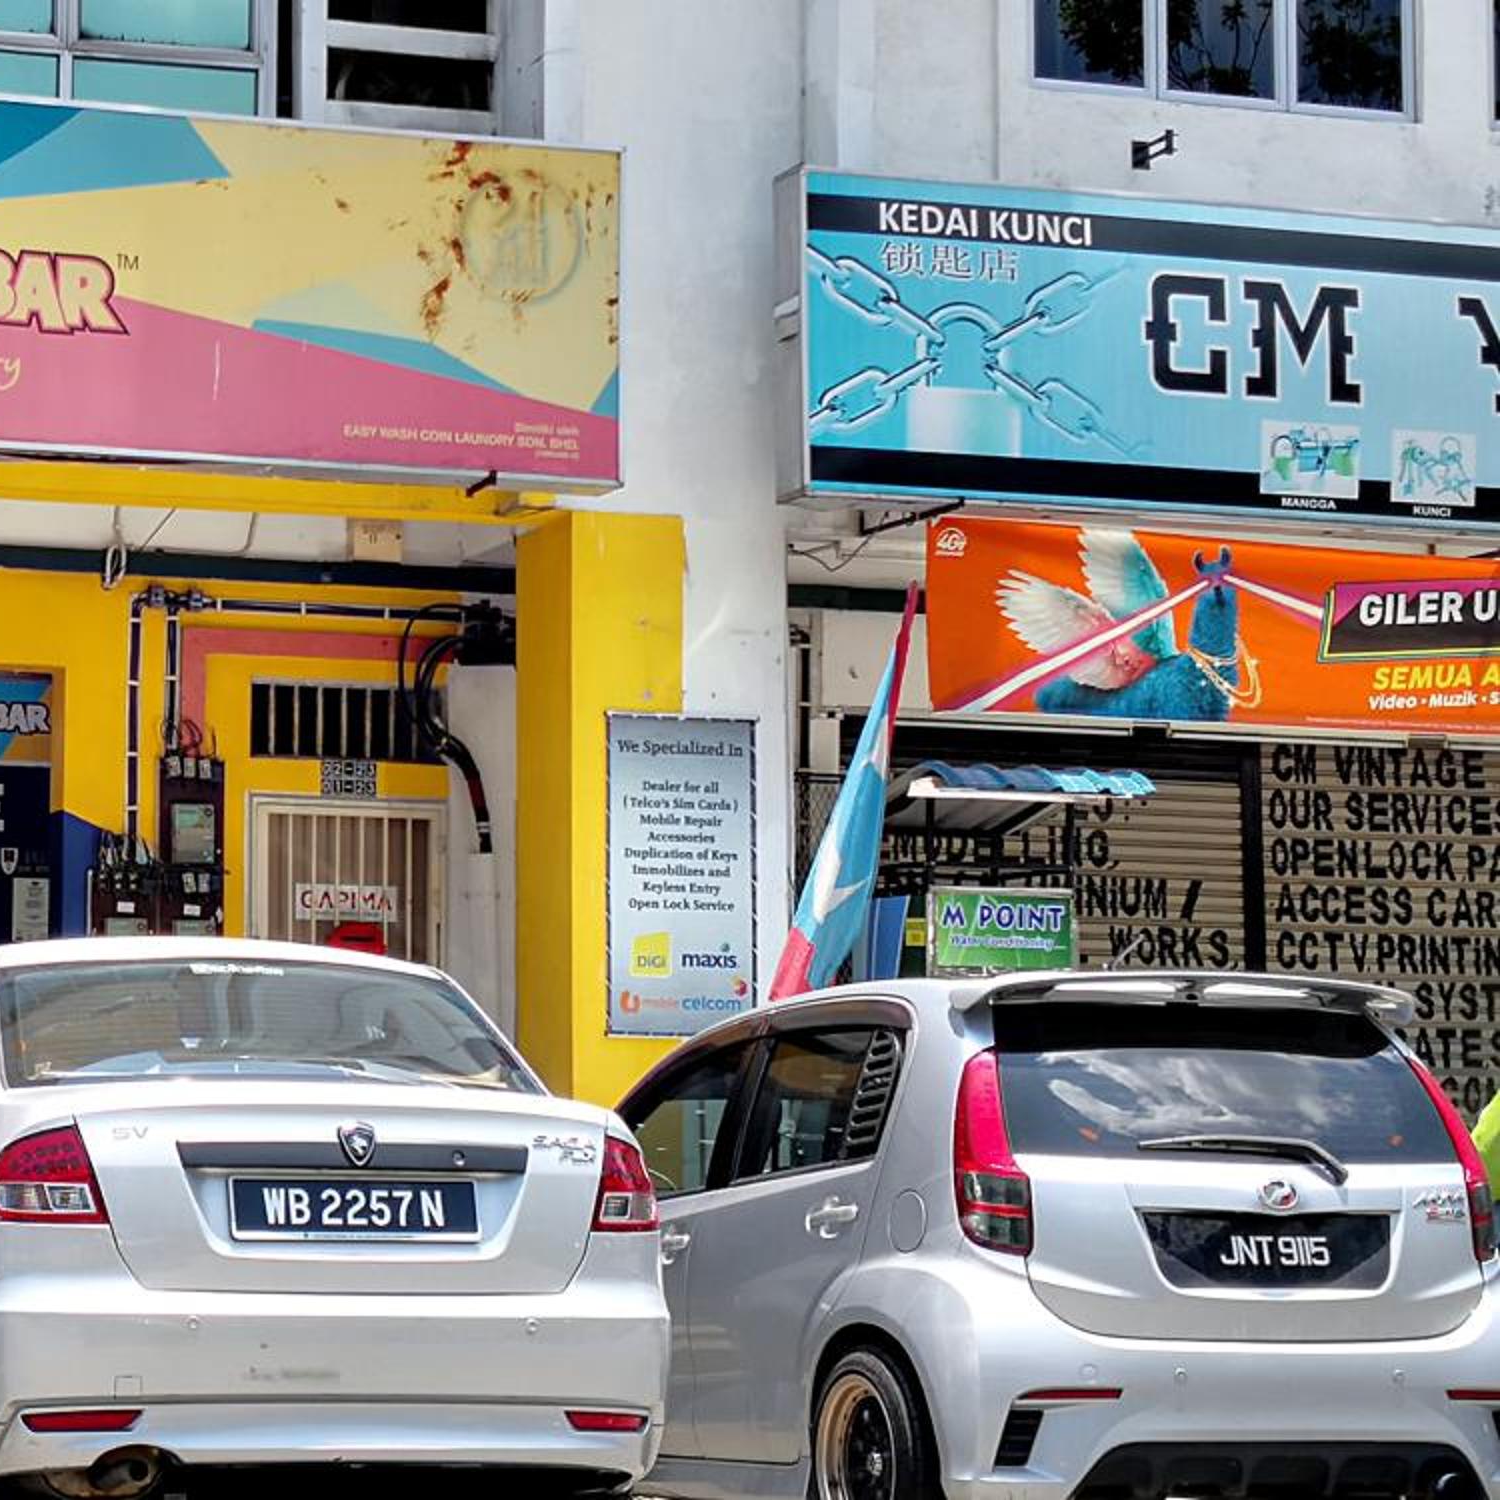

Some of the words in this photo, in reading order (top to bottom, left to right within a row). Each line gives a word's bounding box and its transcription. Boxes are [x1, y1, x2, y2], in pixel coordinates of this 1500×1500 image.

[879, 202, 978, 237] KEDAI
[989, 210, 1092, 246] KUNCI
[879, 241, 1020, 283] 锁匙店
[1144, 271, 1362, 404] CM
[343, 424, 376, 438] EASY
[379, 426, 417, 441] WASH
[420, 429, 452, 443] COIN
[455, 432, 514, 447] LAUNDRY
[1281, 497, 1337, 510] MANGGA
[1413, 505, 1451, 517] KUNCI
[1359, 591, 1463, 626] GILER
[1473, 589, 1500, 622] U
[1373, 664, 1472, 690] SEMUA
[1369, 694, 1417, 711] Video
[1429, 691, 1477, 708] Muzik
[617, 739, 640, 753] We
[642, 740, 724, 757] Specialized
[728, 743, 743, 757] In
[1272, 745, 1317, 784] CM
[1334, 746, 1485, 788] VINTAGE
[643, 780, 681, 792] Dealer
[684, 780, 702, 793] for
[704, 781, 719, 793] all
[672, 799, 695, 809] Sim
[698, 799, 732, 811] Cards
[1269, 788, 1333, 832] OUR
[640, 814, 681, 825] Mobile
[684, 815, 722, 828] Repair
[647, 832, 715, 843] Accessories
[624, 847, 693, 860] Duplication
[696, 848, 709, 860] of
[712, 850, 738, 862] Keys
[708, 866, 731, 877] and
[643, 882, 686, 894] Keyless
[689, 883, 721, 896] Entry
[629, 898, 659, 911] Open
[663, 898, 691, 910] Lock
[693, 899, 735, 911] Service
[1276, 883, 1413, 926] ACCESS
[941, 903, 966, 929] M
[978, 903, 1065, 932] POINT
[681, 947, 738, 968] maxis
[681, 996, 740, 1011] celcom
[111, 1126, 149, 1140] SV
[262, 1187, 311, 1226] WB
[1219, 1235, 1276, 1267] JNT
[1280, 1235, 1331, 1267] 9115
